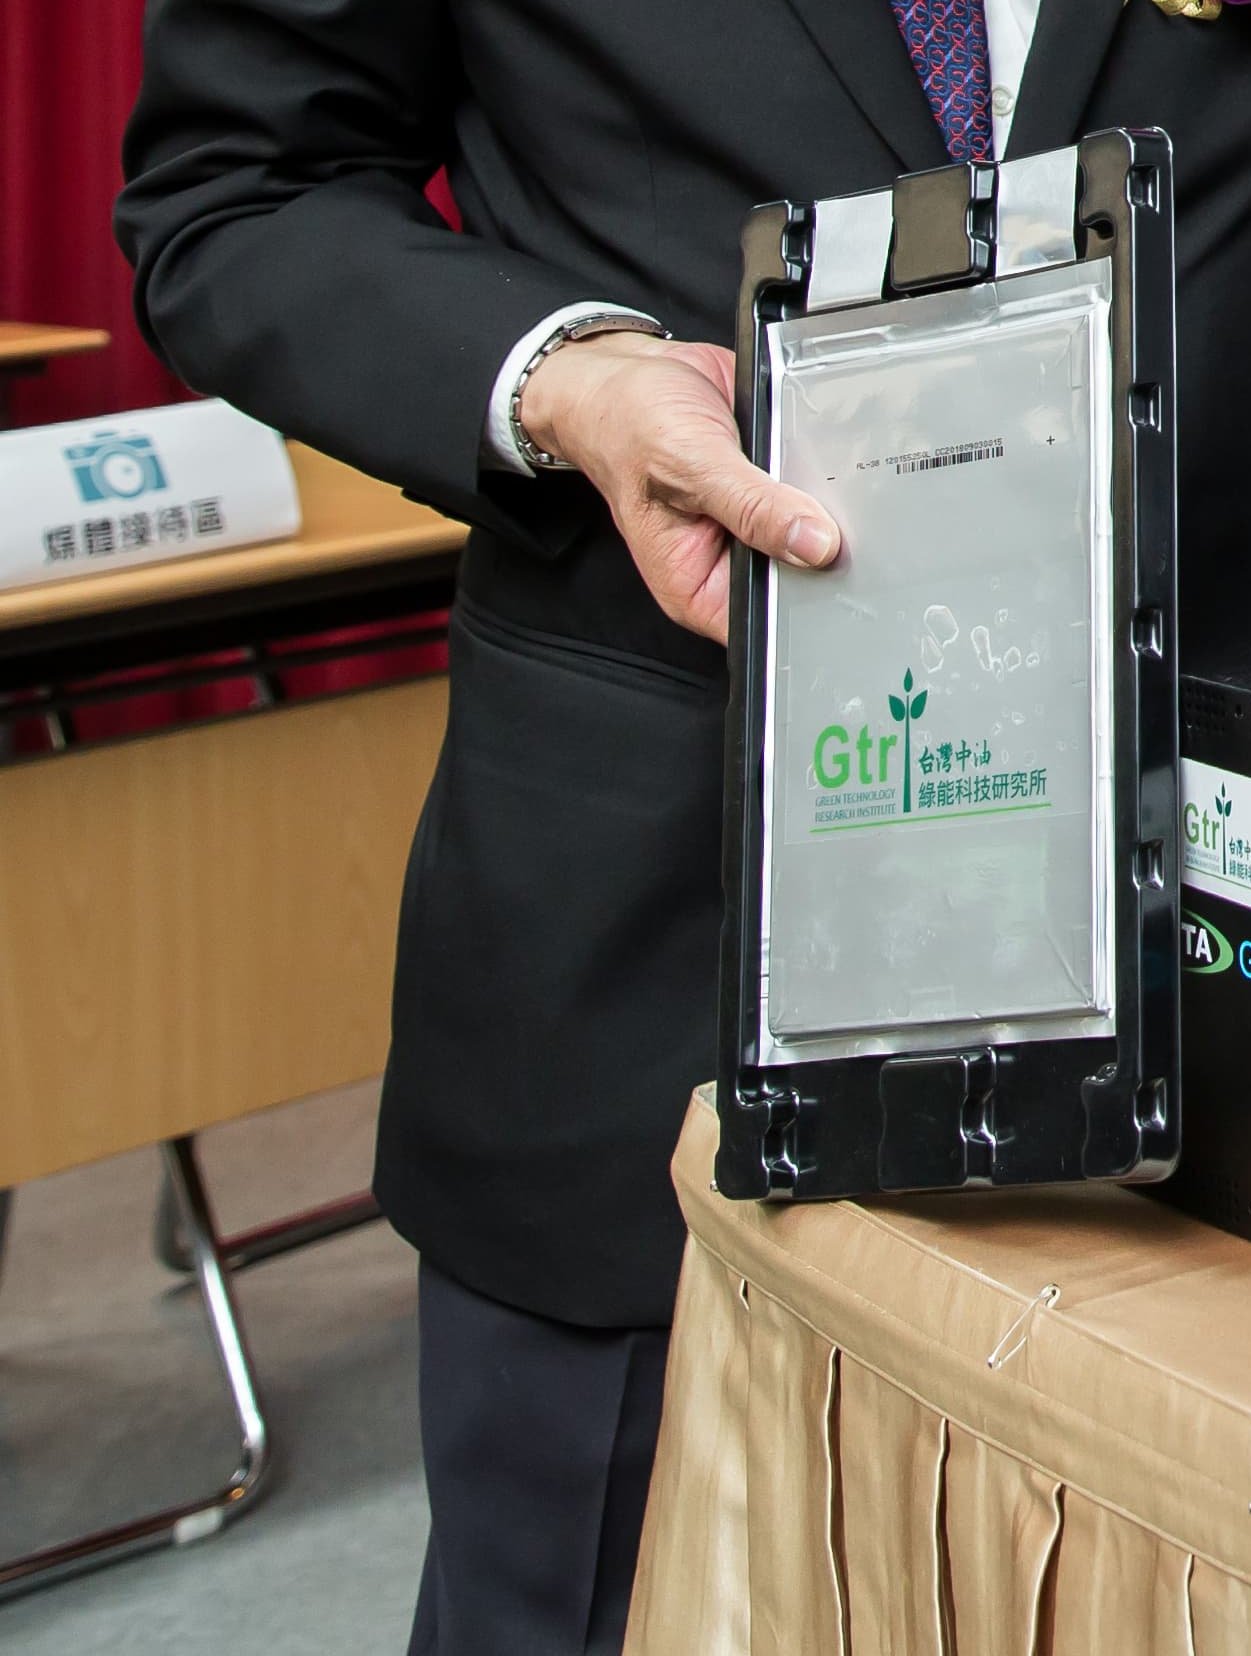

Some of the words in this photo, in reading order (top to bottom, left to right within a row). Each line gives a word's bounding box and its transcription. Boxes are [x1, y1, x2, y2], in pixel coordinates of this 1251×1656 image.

[918, 740, 992, 775] 台灣中油
[918, 768, 1047, 809] 綠能科技研究所
[1181, 922, 1213, 963] TA
